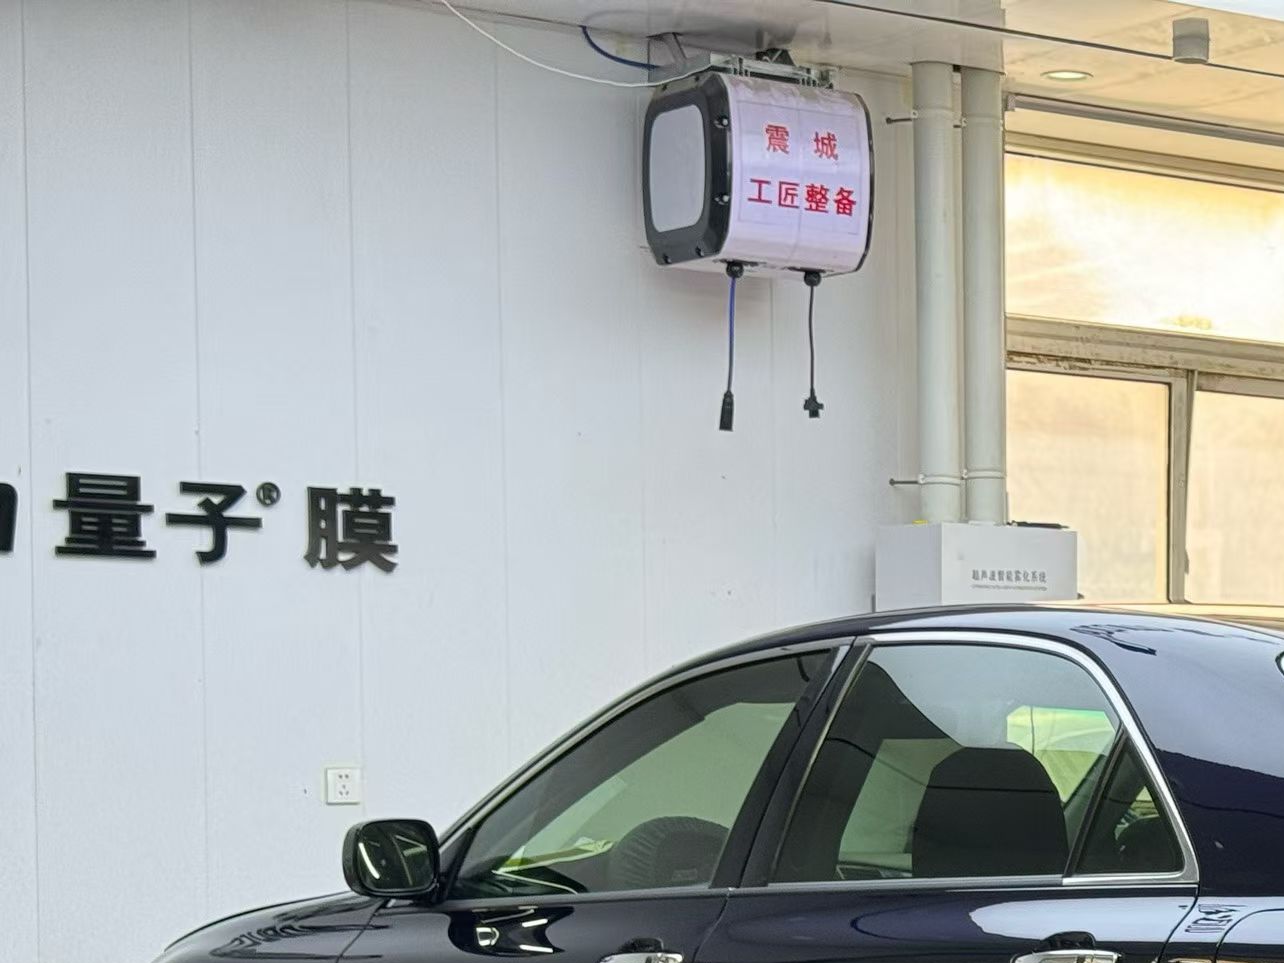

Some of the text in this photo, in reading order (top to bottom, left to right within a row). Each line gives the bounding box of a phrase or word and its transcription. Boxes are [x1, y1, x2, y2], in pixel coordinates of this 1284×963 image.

[765, 124, 839, 161] 震城
[747, 178, 857, 217] 工匠整备
